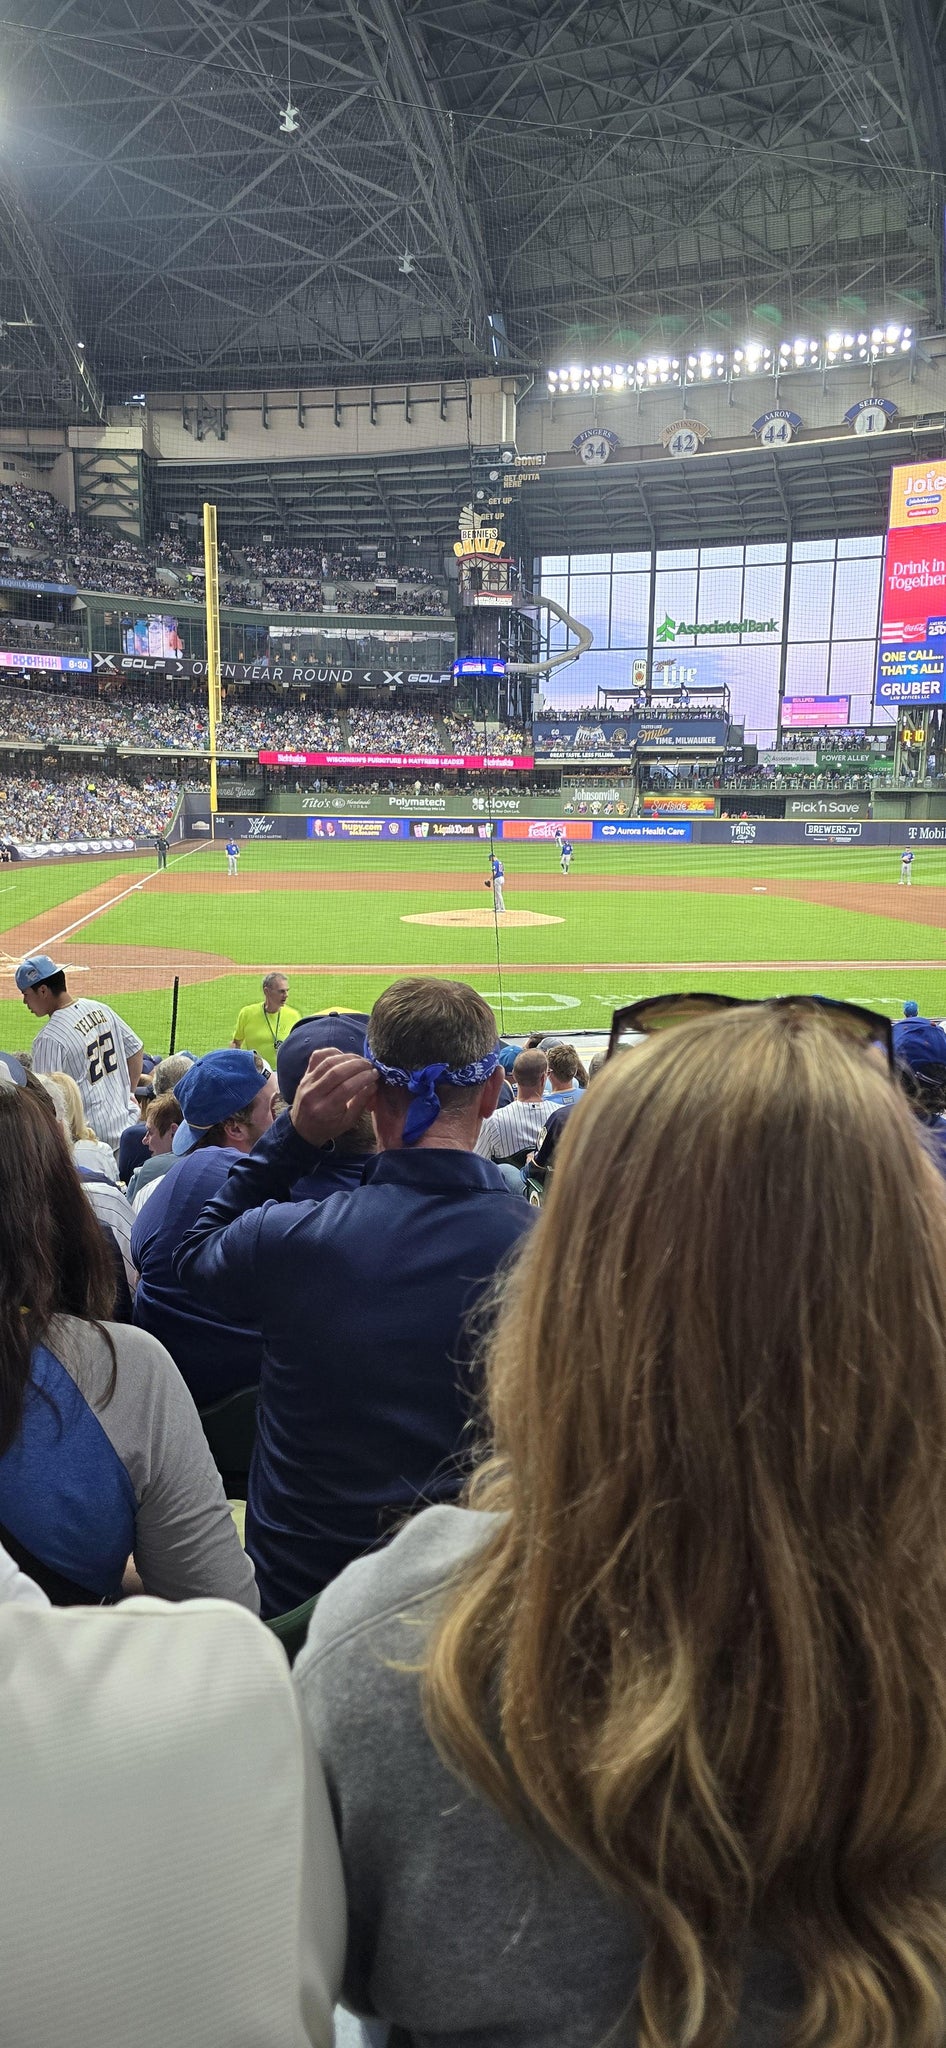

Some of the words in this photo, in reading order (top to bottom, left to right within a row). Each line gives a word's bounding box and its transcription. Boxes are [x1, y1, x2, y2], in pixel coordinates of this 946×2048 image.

[859, 399, 885, 409] SELIG
[764, 411, 791, 422] AARON
[665, 420, 703, 434] ROBINSON
[866, 415, 876, 432] 1
[580, 428, 611, 441] FINGERS
[765, 424, 788, 443] 44
[673, 434, 695, 452] 42
[585, 441, 607, 460] 34
[514, 454, 546, 466] GONE!
[519, 473, 540, 481] OUTTA
[903, 470, 946, 495] Joie
[504, 480, 522, 488] HERE
[462, 529, 498, 539] BERNIE'S
[453, 538, 506, 557] CHALET
[893, 559, 930, 576] Drink
[932, 558, 945, 572] in
[888, 573, 946, 592] Together
[93, 653, 116, 669] X
[121, 658, 166, 670] GOLF
[882, 651, 906, 663] ONE
[908, 650, 944, 661] CALL...
[68, 660, 88, 670] 8:30
[881, 665, 918, 677] THAT'S
[920, 663, 944, 675] ALL!
[242, 665, 284, 680] YEAR
[292, 668, 353, 683] ROUND
[383, 670, 404, 684] X
[407, 674, 451, 684] GOLF
[881, 682, 940, 696] GRUBER
[637, 727, 673, 744] Miller
[655, 737, 675, 745] TIME,
[675, 736, 717, 745] MILWAUKEE
[821, 754, 848, 762] POWER
[848, 754, 870, 762] ALLEY
[572, 788, 620, 801] Johnsonville
[302, 797, 331, 809] Tito's
[389, 797, 446, 808] Polymatech
[484, 798, 521, 809] clover
[651, 800, 687, 812] Surfside
[828, 802, 860, 813] Save
[616, 827, 642, 835] Aurora
[642, 826, 667, 835] Health
[666, 827, 686, 836] Care
[730, 825, 756, 838] TRUSS
[908, 827, 918, 839] T
[74, 1009, 107, 1036] YELICH
[86, 1030, 118, 1086] 22
